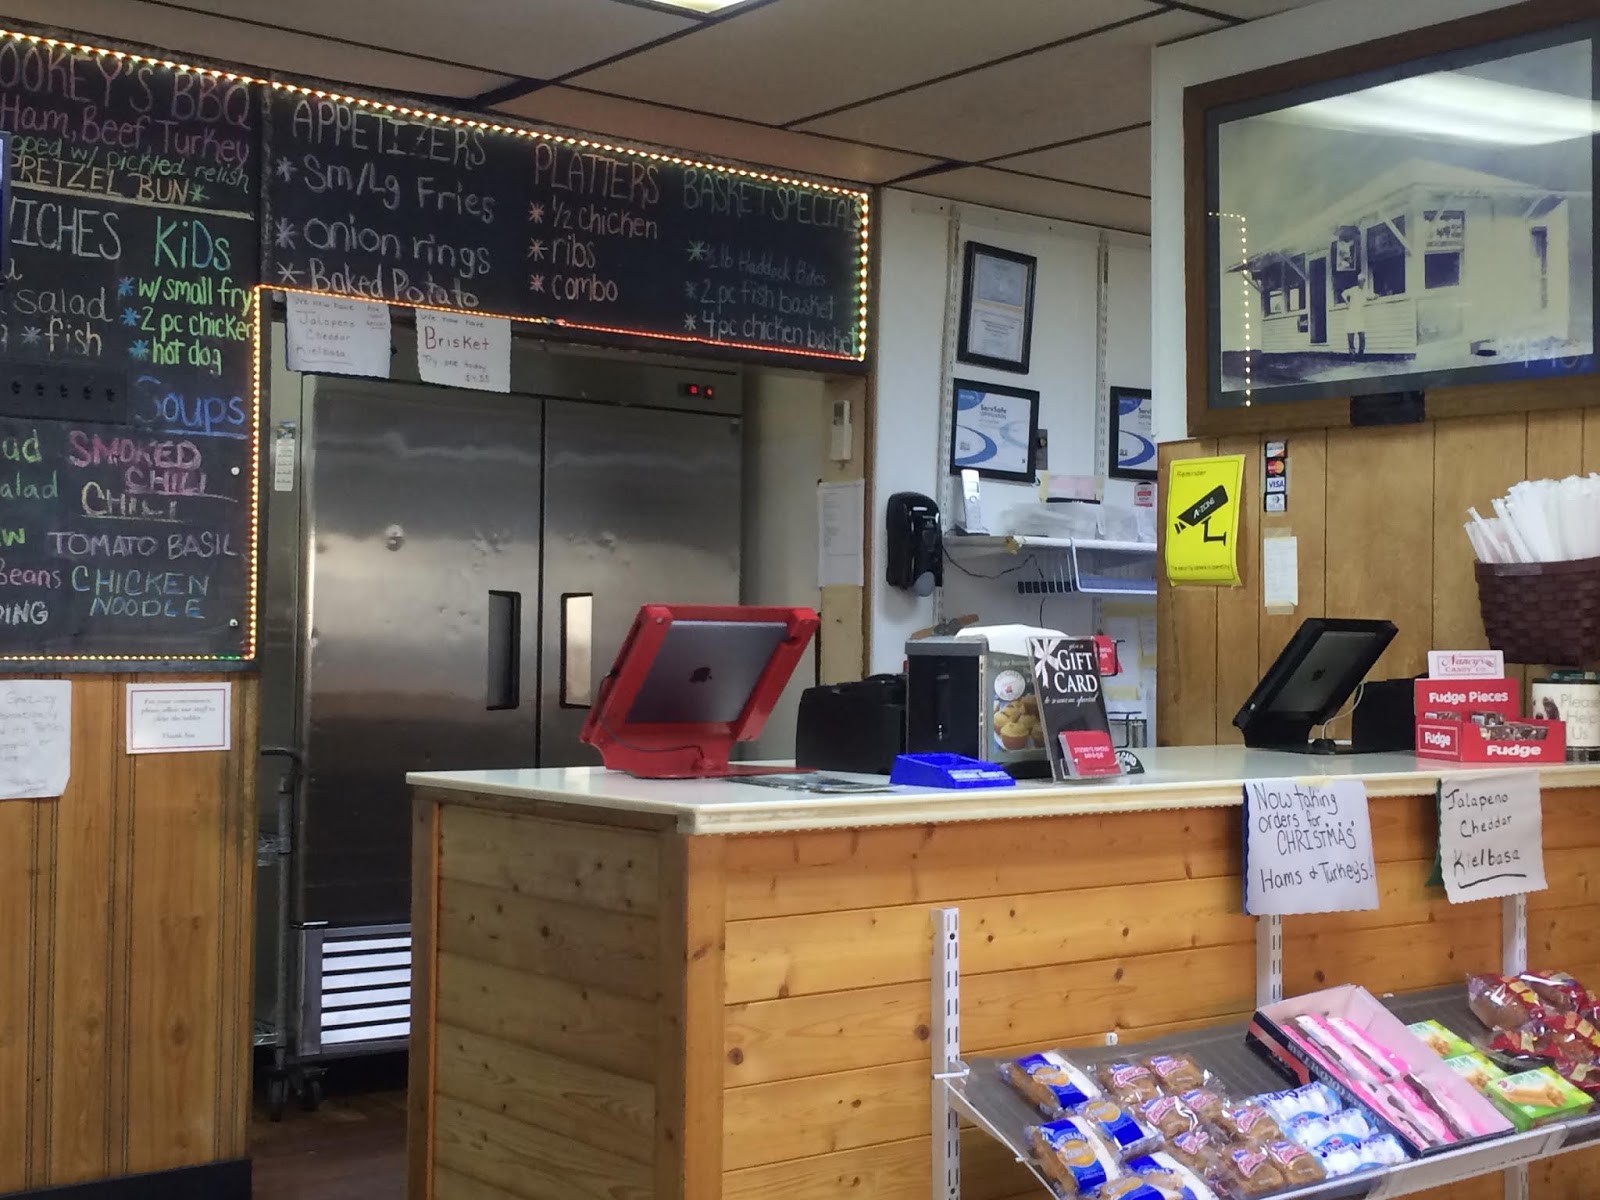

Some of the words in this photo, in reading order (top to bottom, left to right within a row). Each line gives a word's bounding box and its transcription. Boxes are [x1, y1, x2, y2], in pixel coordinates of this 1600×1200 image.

[171, 71, 251, 130] BBQ
[155, 119, 251, 170] Turkey
[128, 171, 190, 206] BUN
[194, 163, 250, 195] relish
[534, 142, 660, 210] PLATTERS
[417, 177, 496, 224] Fries
[683, 167, 773, 219] BASKET
[412, 233, 491, 279] rings
[552, 233, 596, 269] ribs
[217, 276, 253, 317] fry
[308, 257, 385, 298] Baked
[391, 267, 481, 309] Potato
[13, 286, 114, 323] salad
[44, 315, 103, 357] fish
[141, 305, 156, 332] 2
[160, 312, 184, 342] pc
[152, 336, 187, 366] hot
[188, 338, 222, 377] dog
[1269, 480, 1284, 488] VISA
[47, 530, 158, 557] TOMATO
[167, 530, 239, 560] BASIL
[71, 564, 210, 597] CHICKEN
[89, 596, 206, 619] NOODLE
[1057, 649, 1093, 671] GIFT
[1053, 671, 1098, 694] CARD
[1428, 690, 1467, 706] Fudge
[1468, 690, 1509, 703] Pieces
[1424, 731, 1451, 748] Fudge
[1486, 744, 1543, 759] Fudge
[1253, 782, 1293, 811] Now
[1294, 784, 1339, 815] taking
[1444, 788, 1509, 811] Jalapeno
[1258, 811, 1301, 834] orders
[1306, 809, 1321, 827] for
[1460, 815, 1512, 838] Cheddar
[1276, 825, 1357, 856] CHRISTMAS
[1453, 847, 1521, 878] Kielbasa
[1260, 867, 1304, 893] Hams
